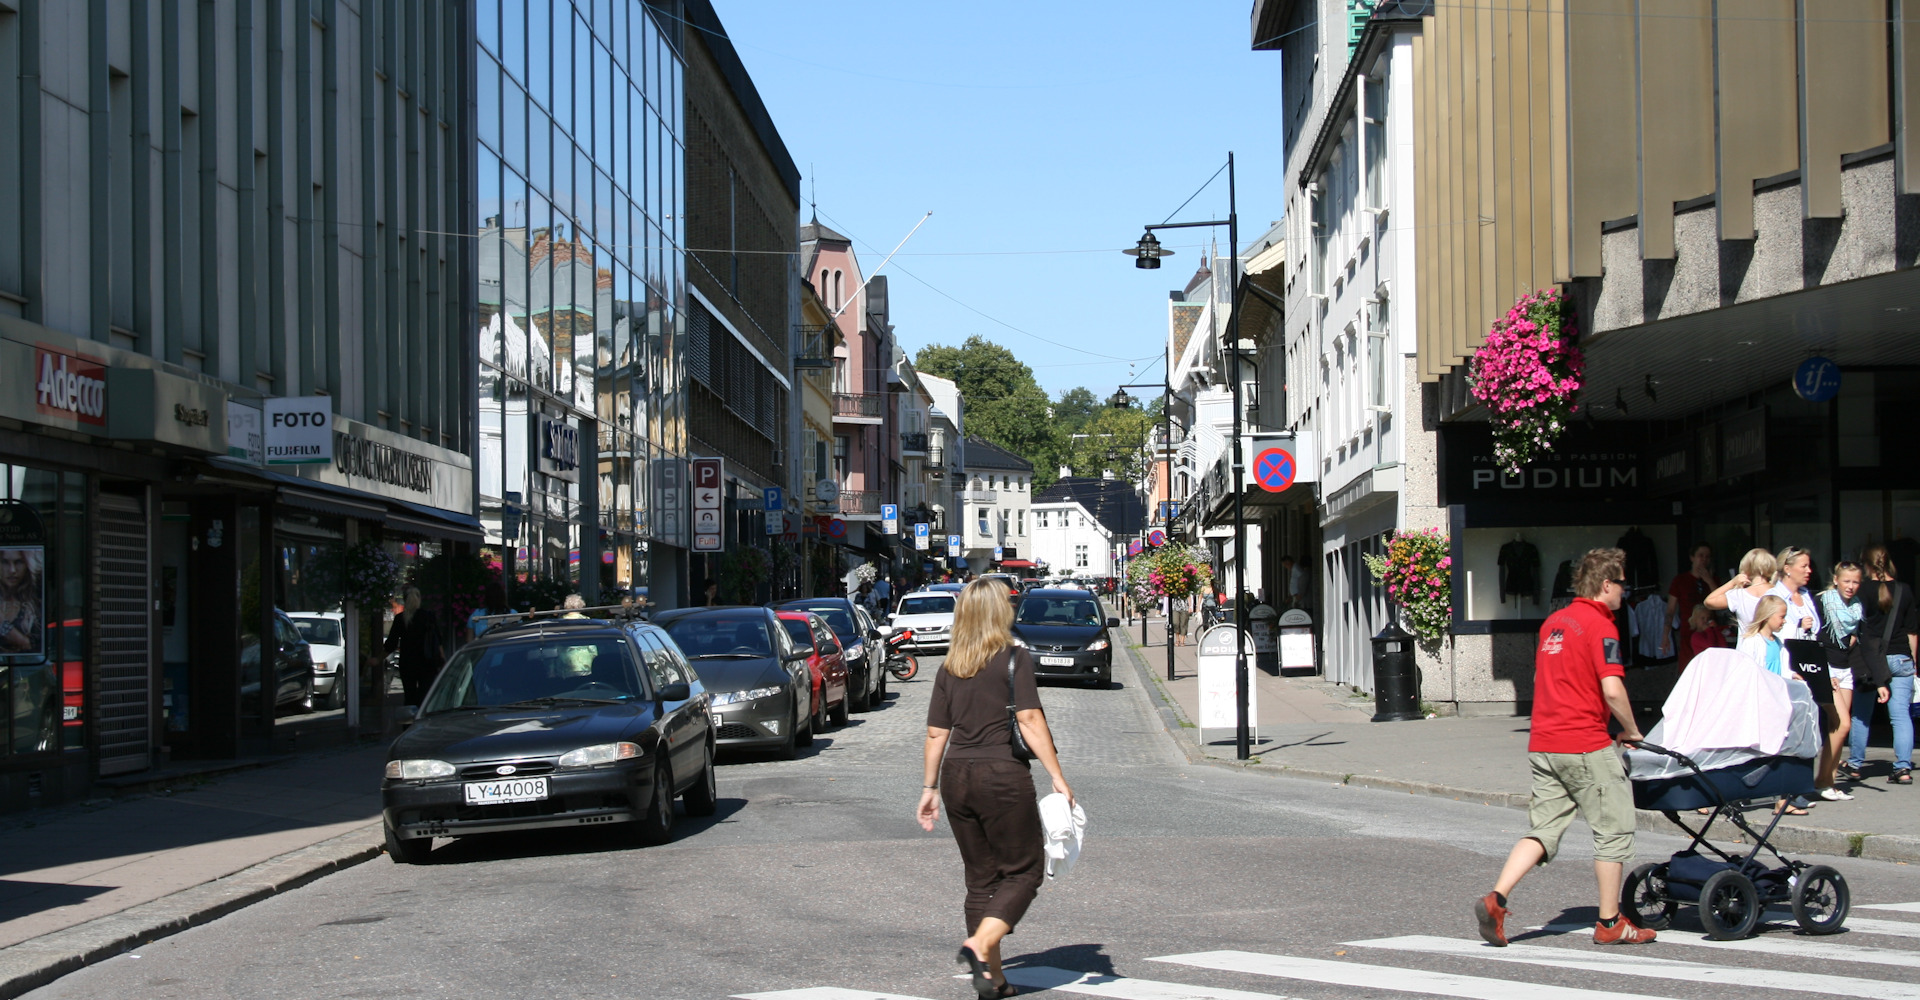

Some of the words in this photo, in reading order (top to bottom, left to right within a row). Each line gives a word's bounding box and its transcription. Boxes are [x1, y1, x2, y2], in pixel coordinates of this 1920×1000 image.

[38, 353, 105, 418] Adecco
[273, 412, 325, 427] FOTO
[267, 445, 320, 456] FUJIFILM
[1570, 453, 1637, 461] PASSION
[701, 467, 715, 484] P
[1472, 467, 1638, 490] PODIUM
[767, 490, 778, 508] P
[884, 506, 894, 519] P
[917, 525, 926, 535] P
[698, 537, 717, 546] Fullt
[951, 536, 958, 545] P
[1603, 638, 1620, 663] 7
[467, 785, 488, 799] LY
[492, 781, 545, 797] 44008
